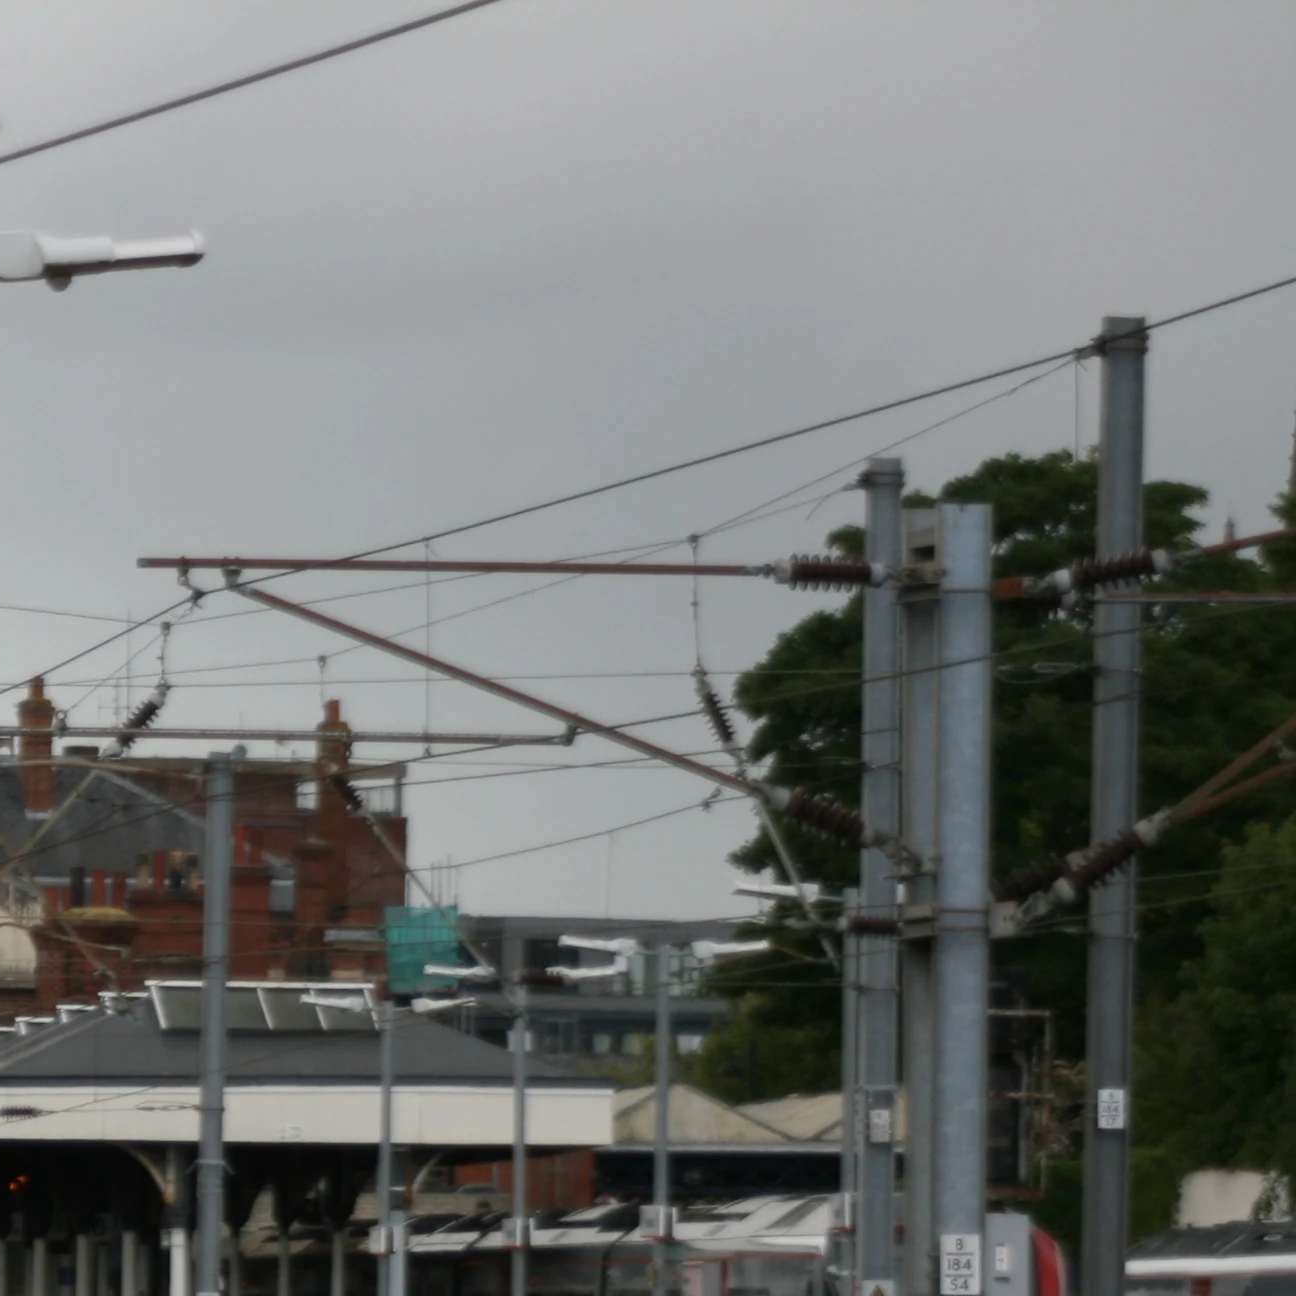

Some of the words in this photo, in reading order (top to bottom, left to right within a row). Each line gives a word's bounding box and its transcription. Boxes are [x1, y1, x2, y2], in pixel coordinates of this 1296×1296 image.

[956, 1239, 963, 1250] B
[947, 1258, 972, 1271] 184
[949, 1278, 969, 1291] 54
